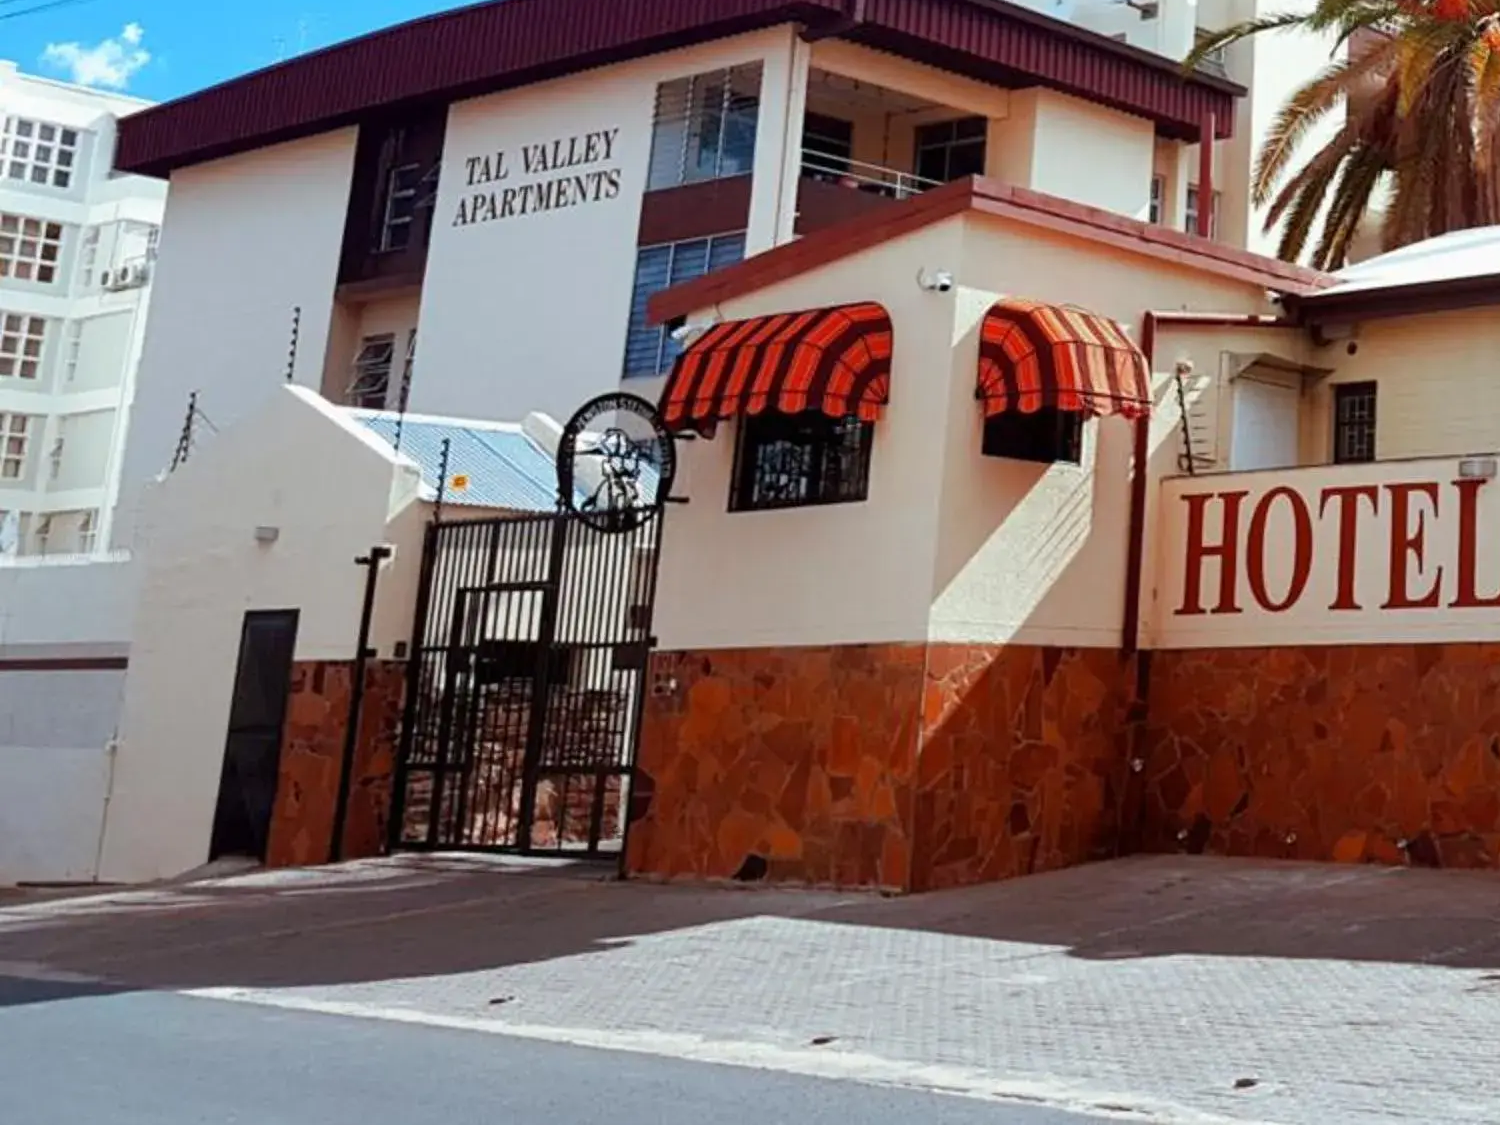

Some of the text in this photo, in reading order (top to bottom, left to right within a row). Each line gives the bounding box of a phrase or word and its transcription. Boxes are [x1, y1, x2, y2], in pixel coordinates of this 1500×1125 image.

[466, 127, 620, 186] TAL VALLEY
[452, 168, 622, 227] APARTMENTS
